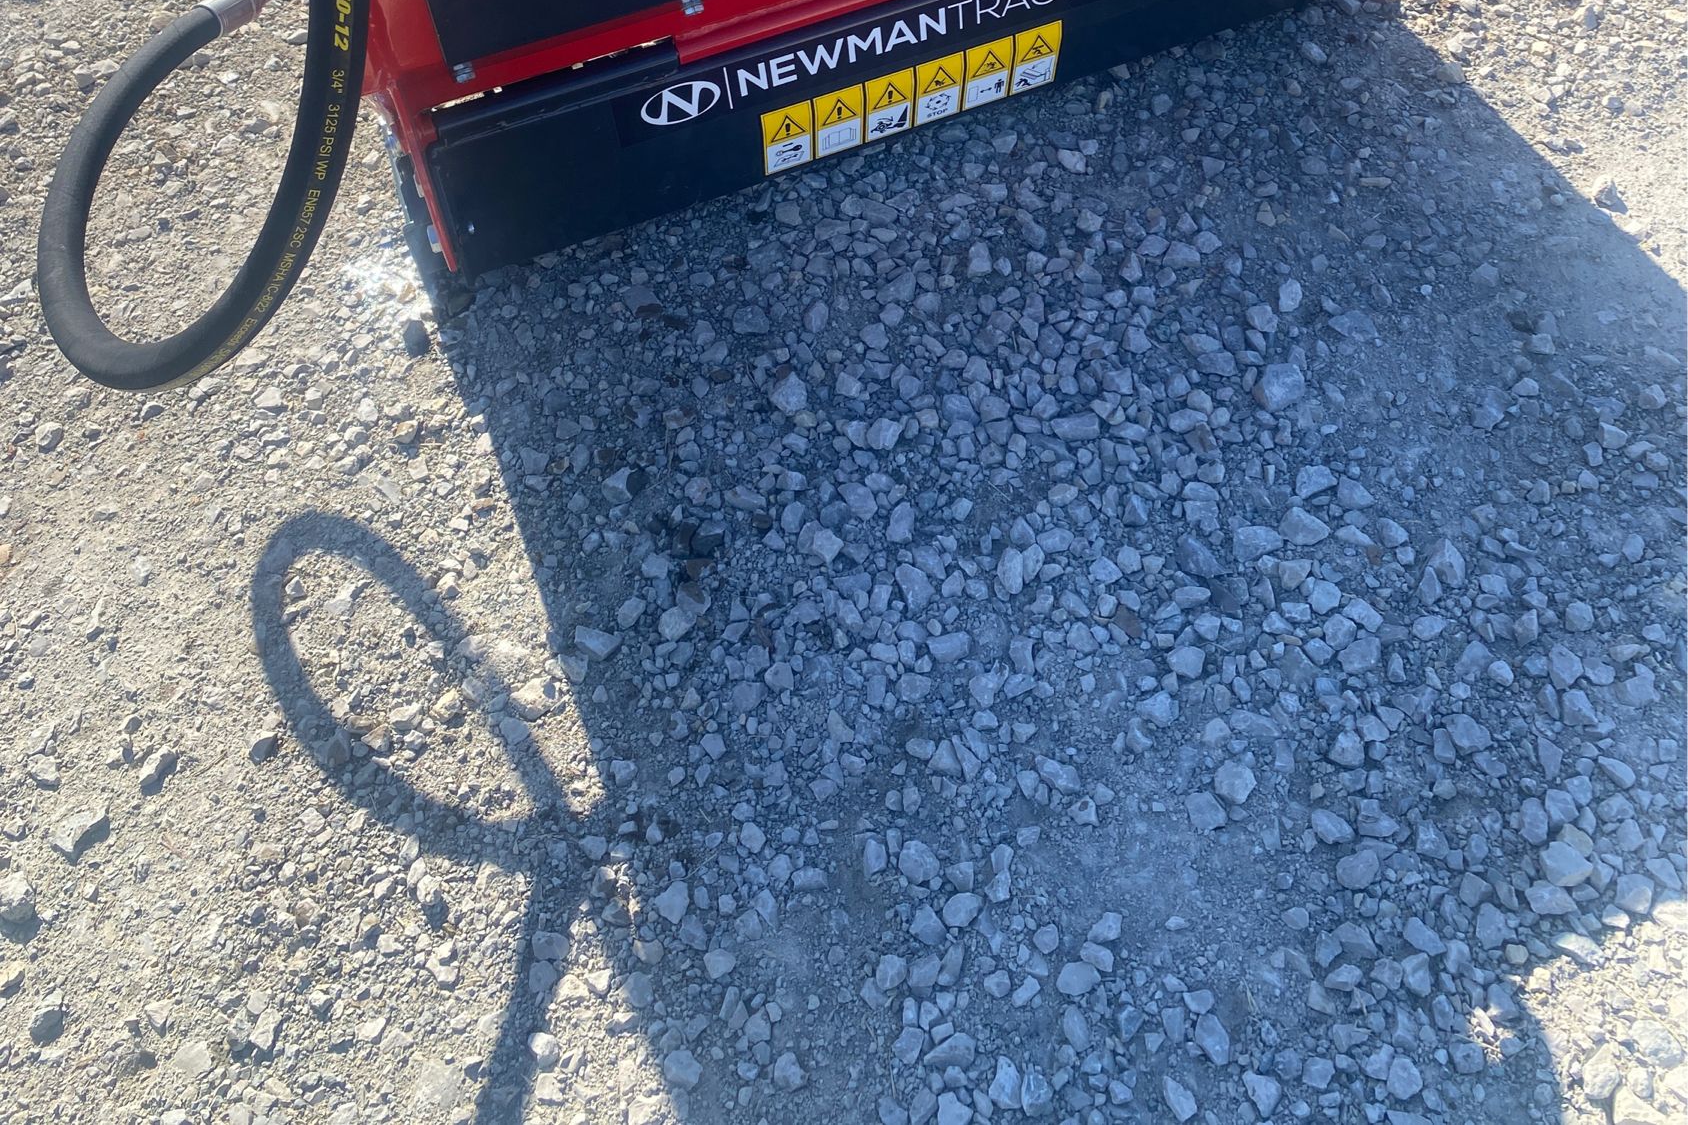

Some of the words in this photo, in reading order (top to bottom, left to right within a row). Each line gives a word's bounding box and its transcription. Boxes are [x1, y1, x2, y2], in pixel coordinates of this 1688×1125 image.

[324, 104, 340, 134] 3125
[927, 108, 948, 118] STOP
[318, 136, 334, 158] PSI
[314, 160, 329, 180] WP
[300, 189, 321, 225] EN857
[289, 226, 308, 249] 2SC
[271, 252, 297, 282] MSHA
